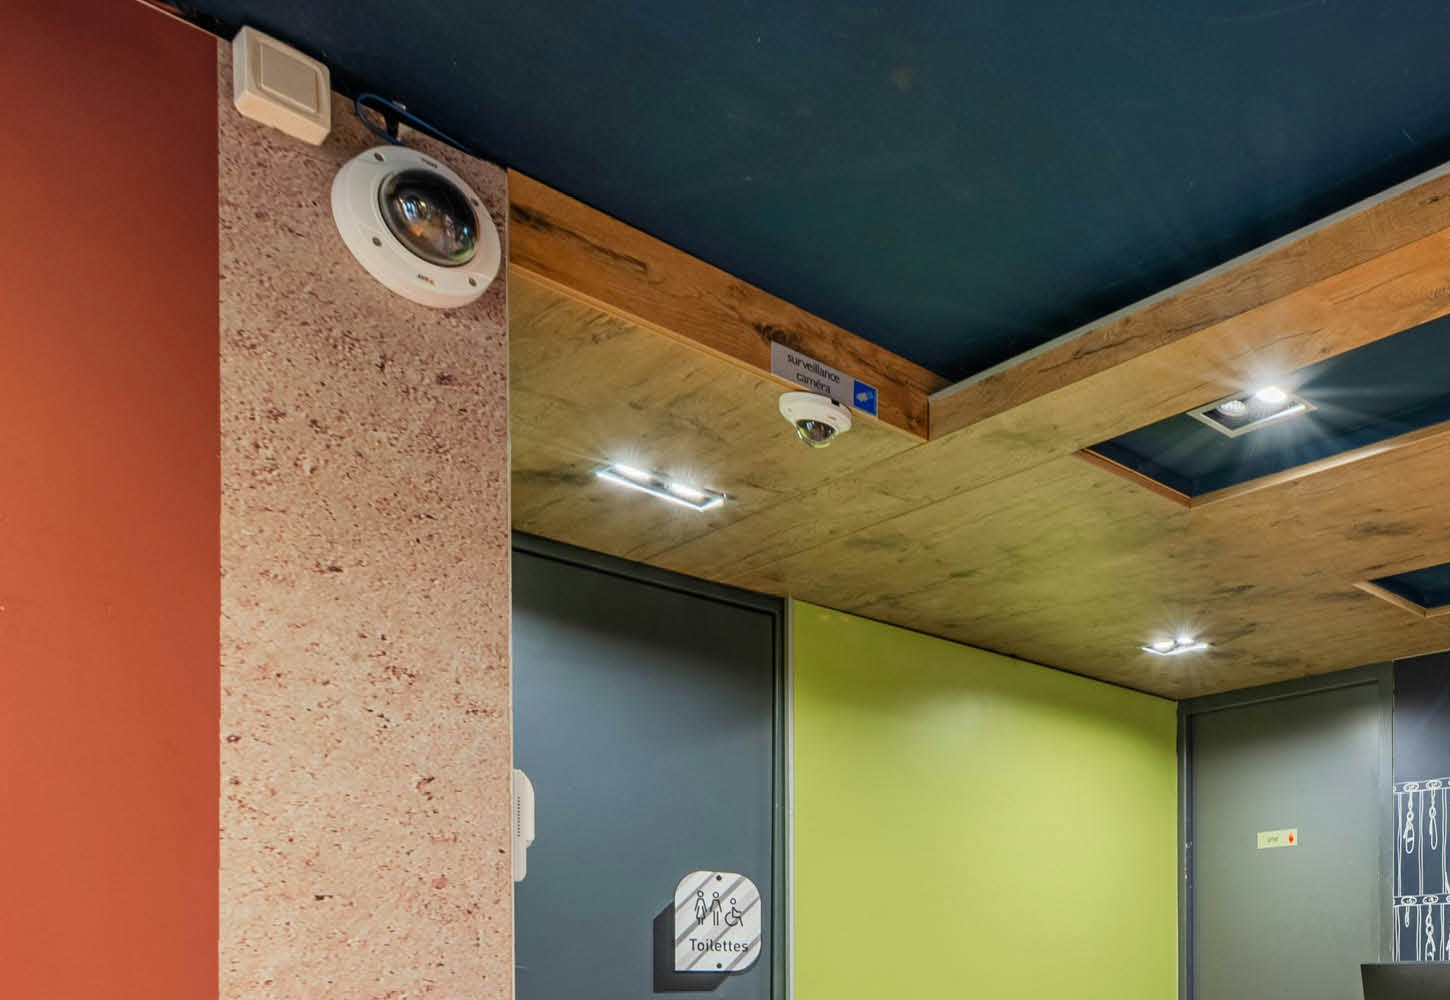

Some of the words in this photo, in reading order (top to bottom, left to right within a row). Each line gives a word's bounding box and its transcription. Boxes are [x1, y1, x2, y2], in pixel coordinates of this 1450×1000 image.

[787, 354, 840, 384] surveillance
[796, 371, 831, 394] caméra
[689, 938, 749, 953] Toilettes
